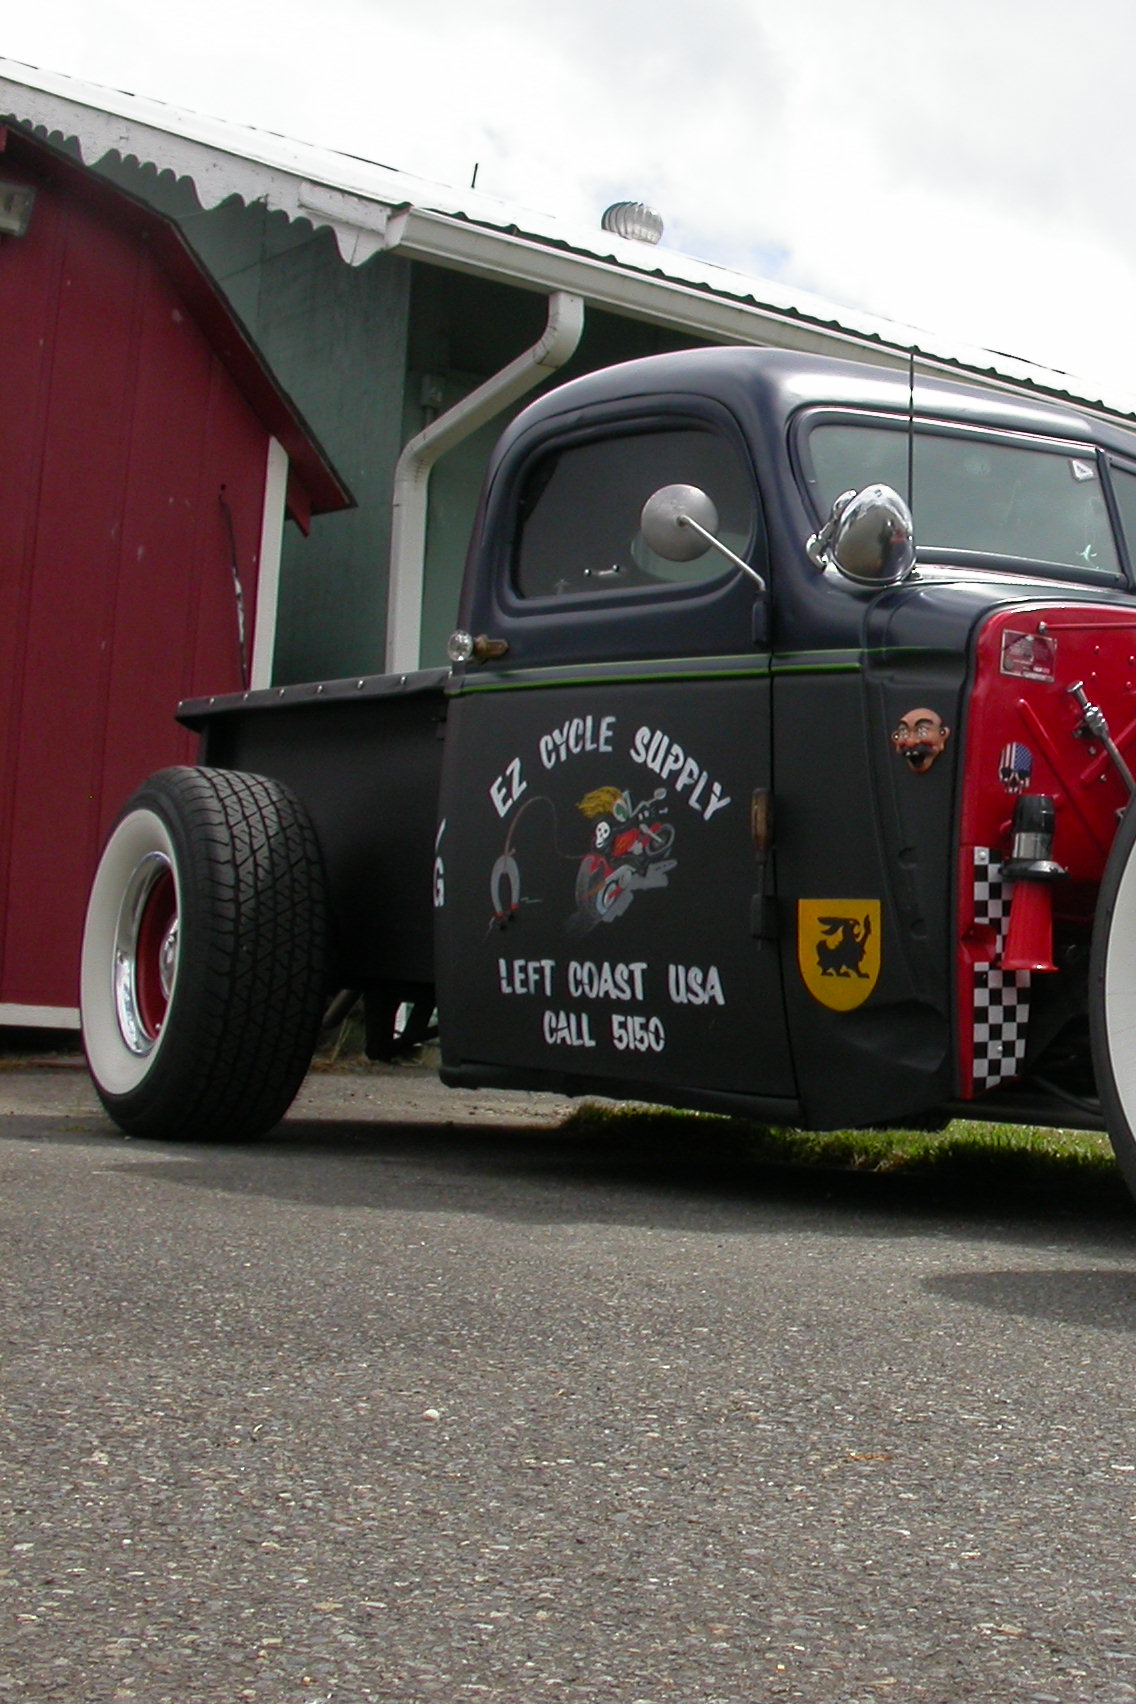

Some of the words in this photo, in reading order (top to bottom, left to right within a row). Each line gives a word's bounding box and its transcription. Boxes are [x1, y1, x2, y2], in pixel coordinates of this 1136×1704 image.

[489, 757, 527, 818] EZ
[539, 715, 616, 770] CYCLE
[630, 726, 731, 821] SUPPLY
[499, 958, 555, 996] LEFT
[568, 961, 648, 1001] COAST
[668, 963, 725, 1006] USA
[543, 1010, 596, 1047] CALL
[612, 1014, 665, 1052] 5150
